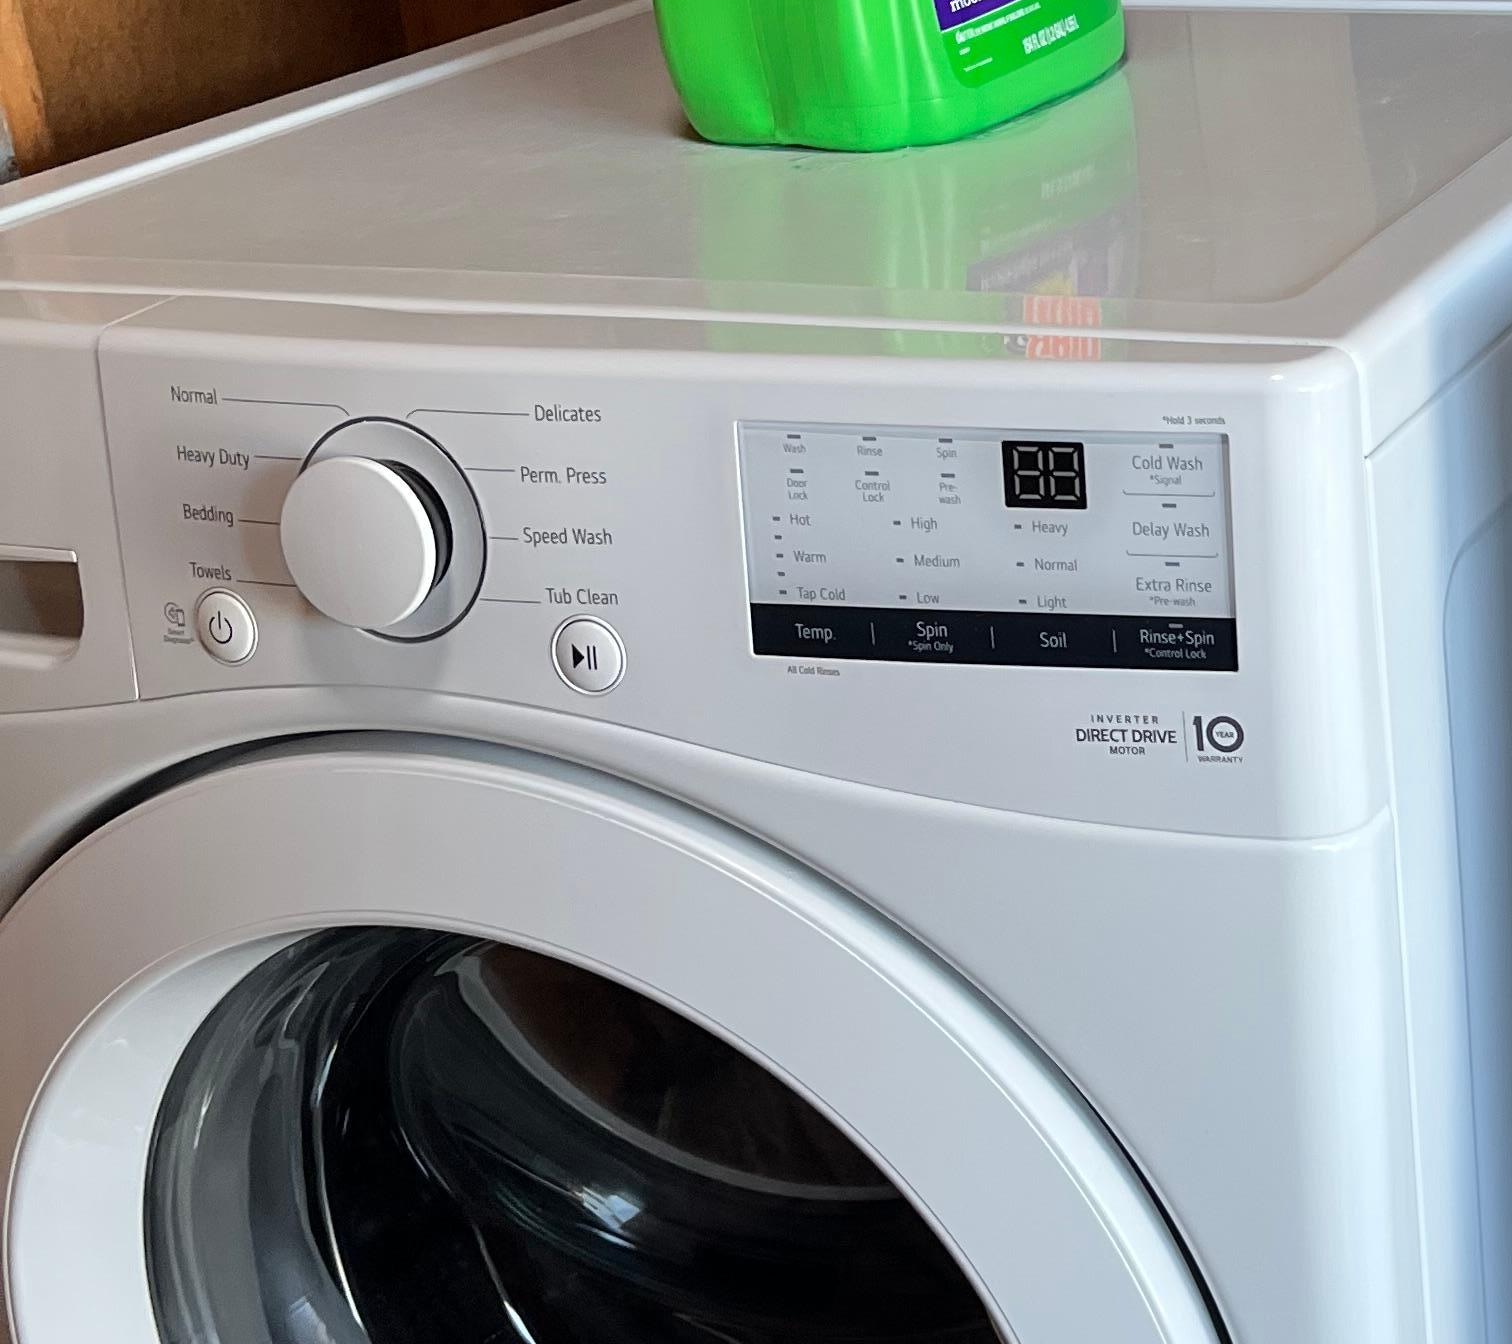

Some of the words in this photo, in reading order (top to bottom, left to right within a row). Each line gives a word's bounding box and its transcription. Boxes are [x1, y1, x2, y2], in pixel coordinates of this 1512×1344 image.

[170, 385, 218, 405] Normal
[534, 404, 602, 423] Delicates
[783, 443, 807, 454] Wash
[856, 445, 883, 457] Rinse
[936, 447, 957, 460] Spin
[176, 445, 216, 468] Heavy
[219, 448, 250, 471] Duty
[1132, 455, 1163, 471] Cold
[1166, 456, 1203, 471] Wash
[520, 465, 563, 485] Perm.
[566, 467, 607, 485] Press
[855, 479, 891, 492] Control
[862, 492, 885, 503] Lock
[938, 493, 962, 505] wash
[182, 503, 234, 528] Bedding
[789, 513, 812, 527] Hot
[910, 516, 938, 533] High
[1031, 520, 1069, 537] Heavy
[1132, 521, 1170, 541] Delay
[1173, 523, 1210, 538] Wash
[523, 526, 568, 548] Speed
[571, 527, 613, 546] Wash
[792, 550, 827, 564] Warm
[913, 554, 961, 568] Medium
[1034, 558, 1078, 572] Normal
[188, 561, 232, 582] Towels
[1135, 576, 1171, 592] Extra
[1175, 578, 1213, 593] Rinse
[545, 587, 572, 605] Tub
[576, 588, 619, 606] Clean
[796, 586, 817, 602] Tap
[819, 587, 846, 601] Cold
[916, 592, 940, 605] Low
[1036, 595, 1068, 611] Light
[794, 623, 837, 644] Temp.
[915, 620, 949, 641] Spin
[1139, 628, 1216, 648] Rinse+Spin
[934, 641, 954, 655] Only
[1039, 631, 1068, 649] Soil
[1185, 648, 1207, 660] Lock
[1090, 714, 1160, 725] INVERTER
[1075, 728, 1129, 743] DIRECT
[1132, 729, 1178, 744] DRIVE
[1192, 715, 1245, 753] 10
[1215, 730, 1235, 739] YEAR
[1109, 745, 1146, 756] MOTOR
